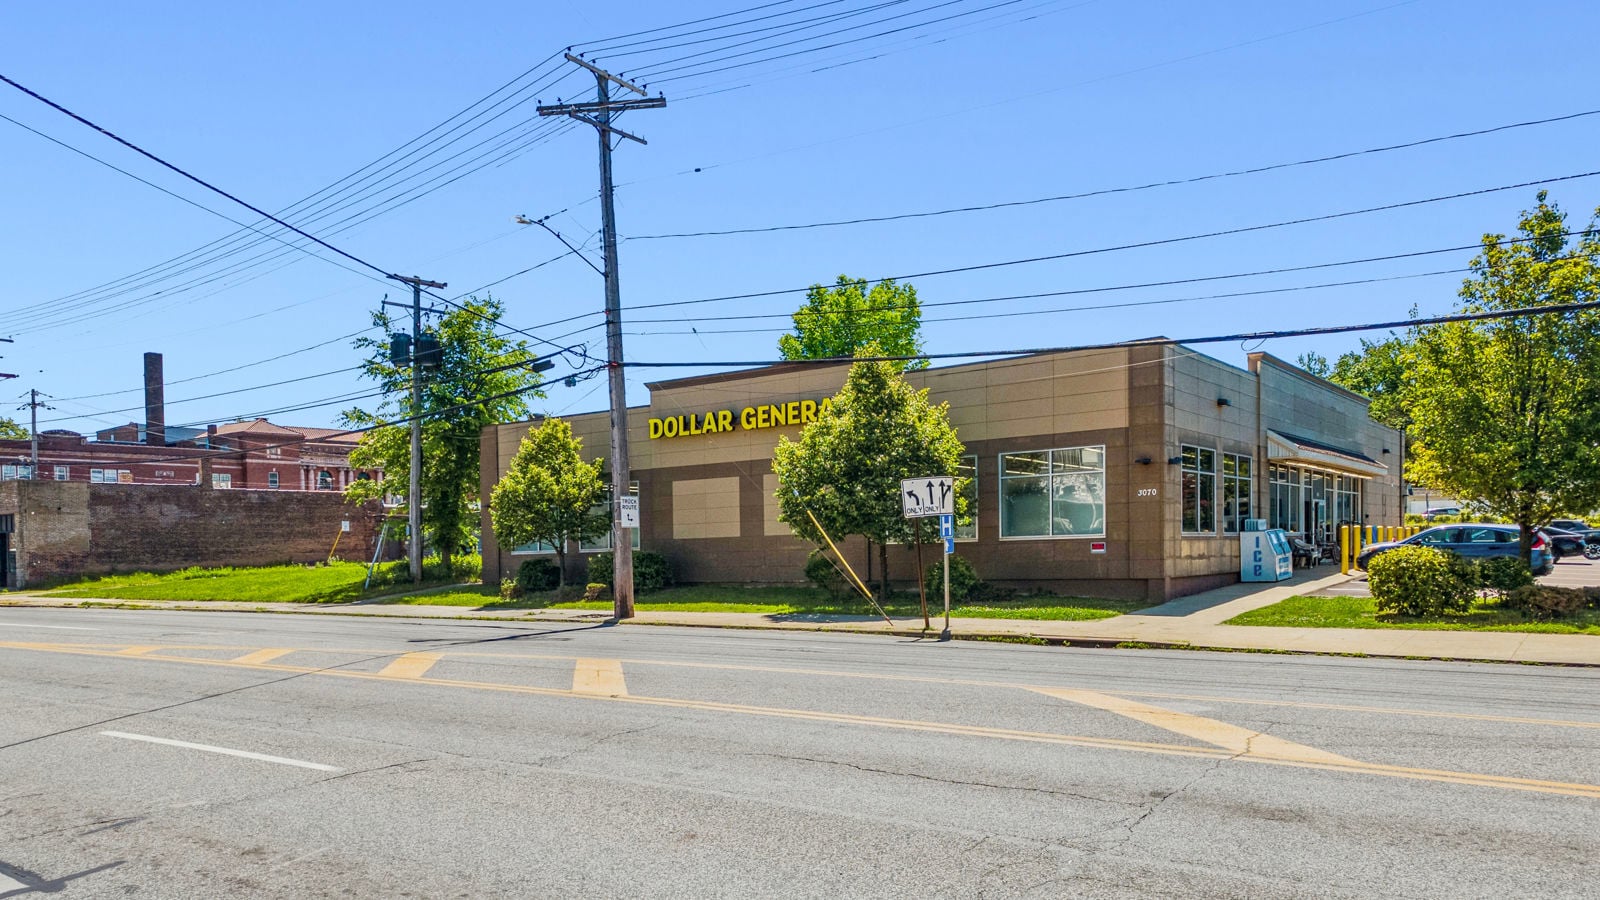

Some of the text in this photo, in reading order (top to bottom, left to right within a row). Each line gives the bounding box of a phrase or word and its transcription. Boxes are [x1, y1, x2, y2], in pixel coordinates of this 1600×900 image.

[649, 396, 834, 439] DOLLAR GENERA
[1137, 488, 1157, 497] 3070
[906, 506, 923, 514] ONLY
[941, 515, 952, 536] H
